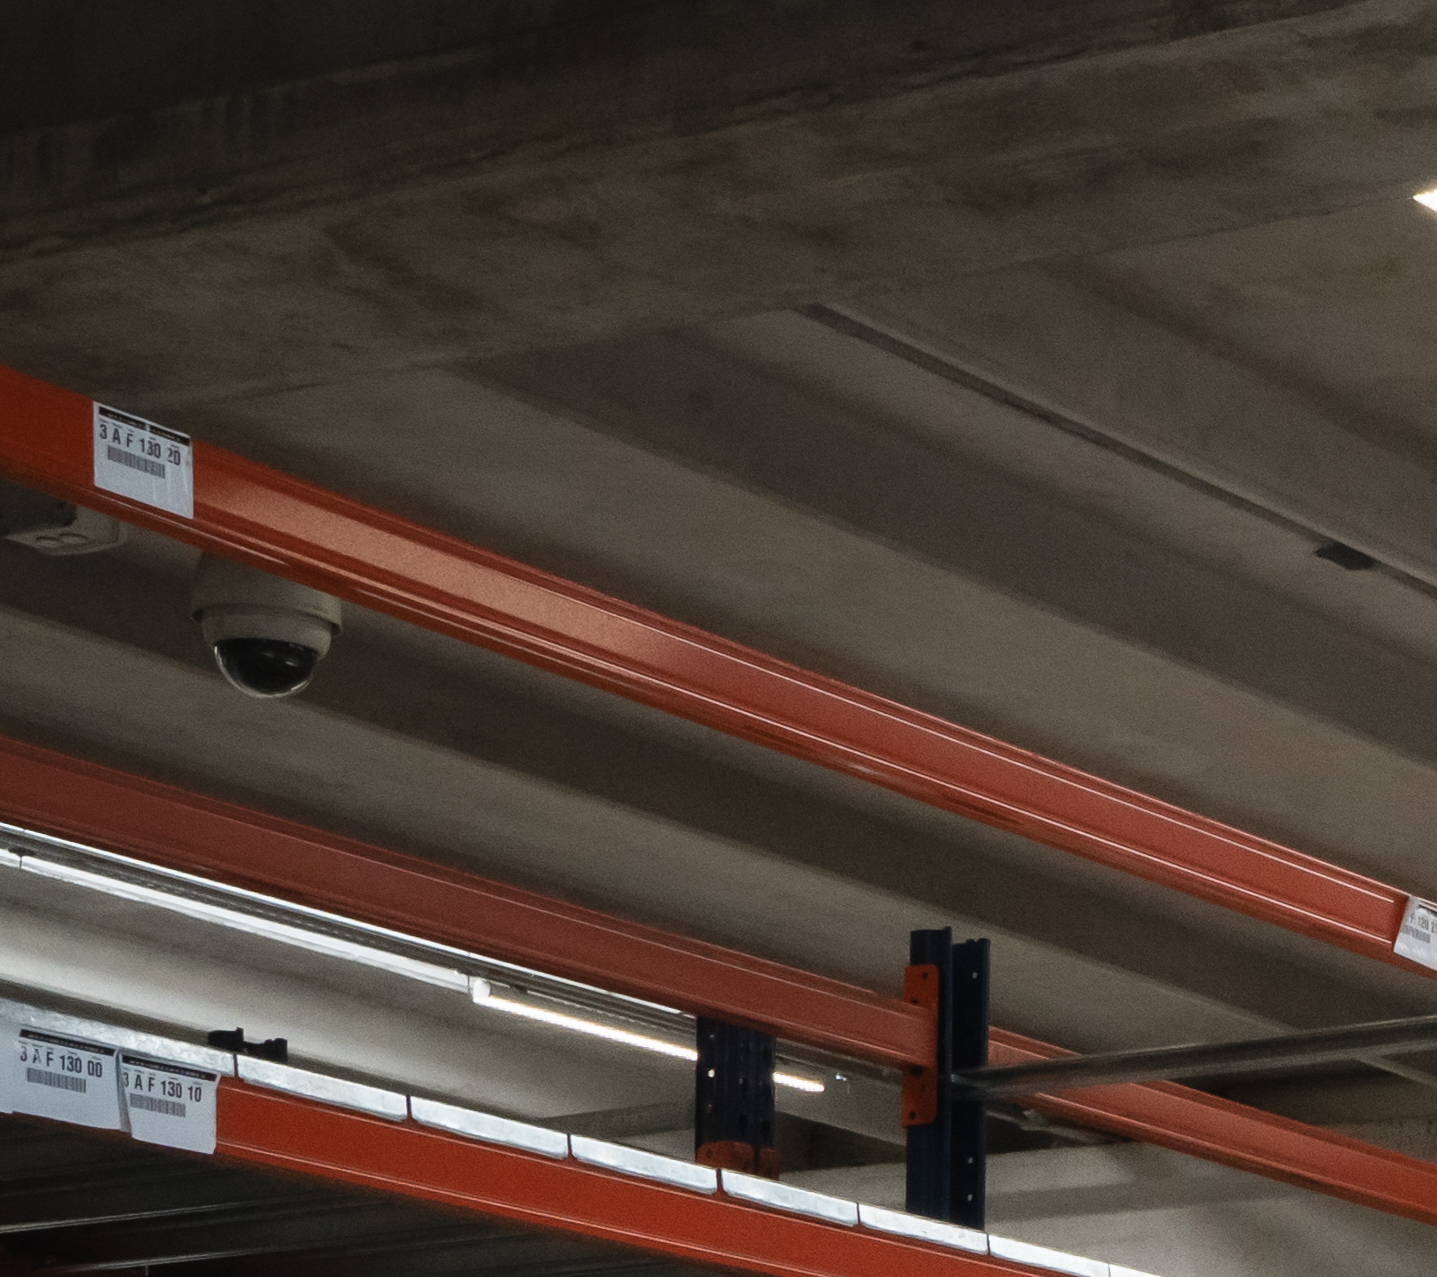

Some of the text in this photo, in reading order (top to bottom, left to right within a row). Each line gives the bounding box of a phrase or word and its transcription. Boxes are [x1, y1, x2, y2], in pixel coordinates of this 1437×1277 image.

[112, 427, 121, 447] A
[126, 433, 134, 448] F
[20, 1048, 103, 1077] 3 A F 130 00
[123, 1072, 202, 1102] 3 A F 130 10
